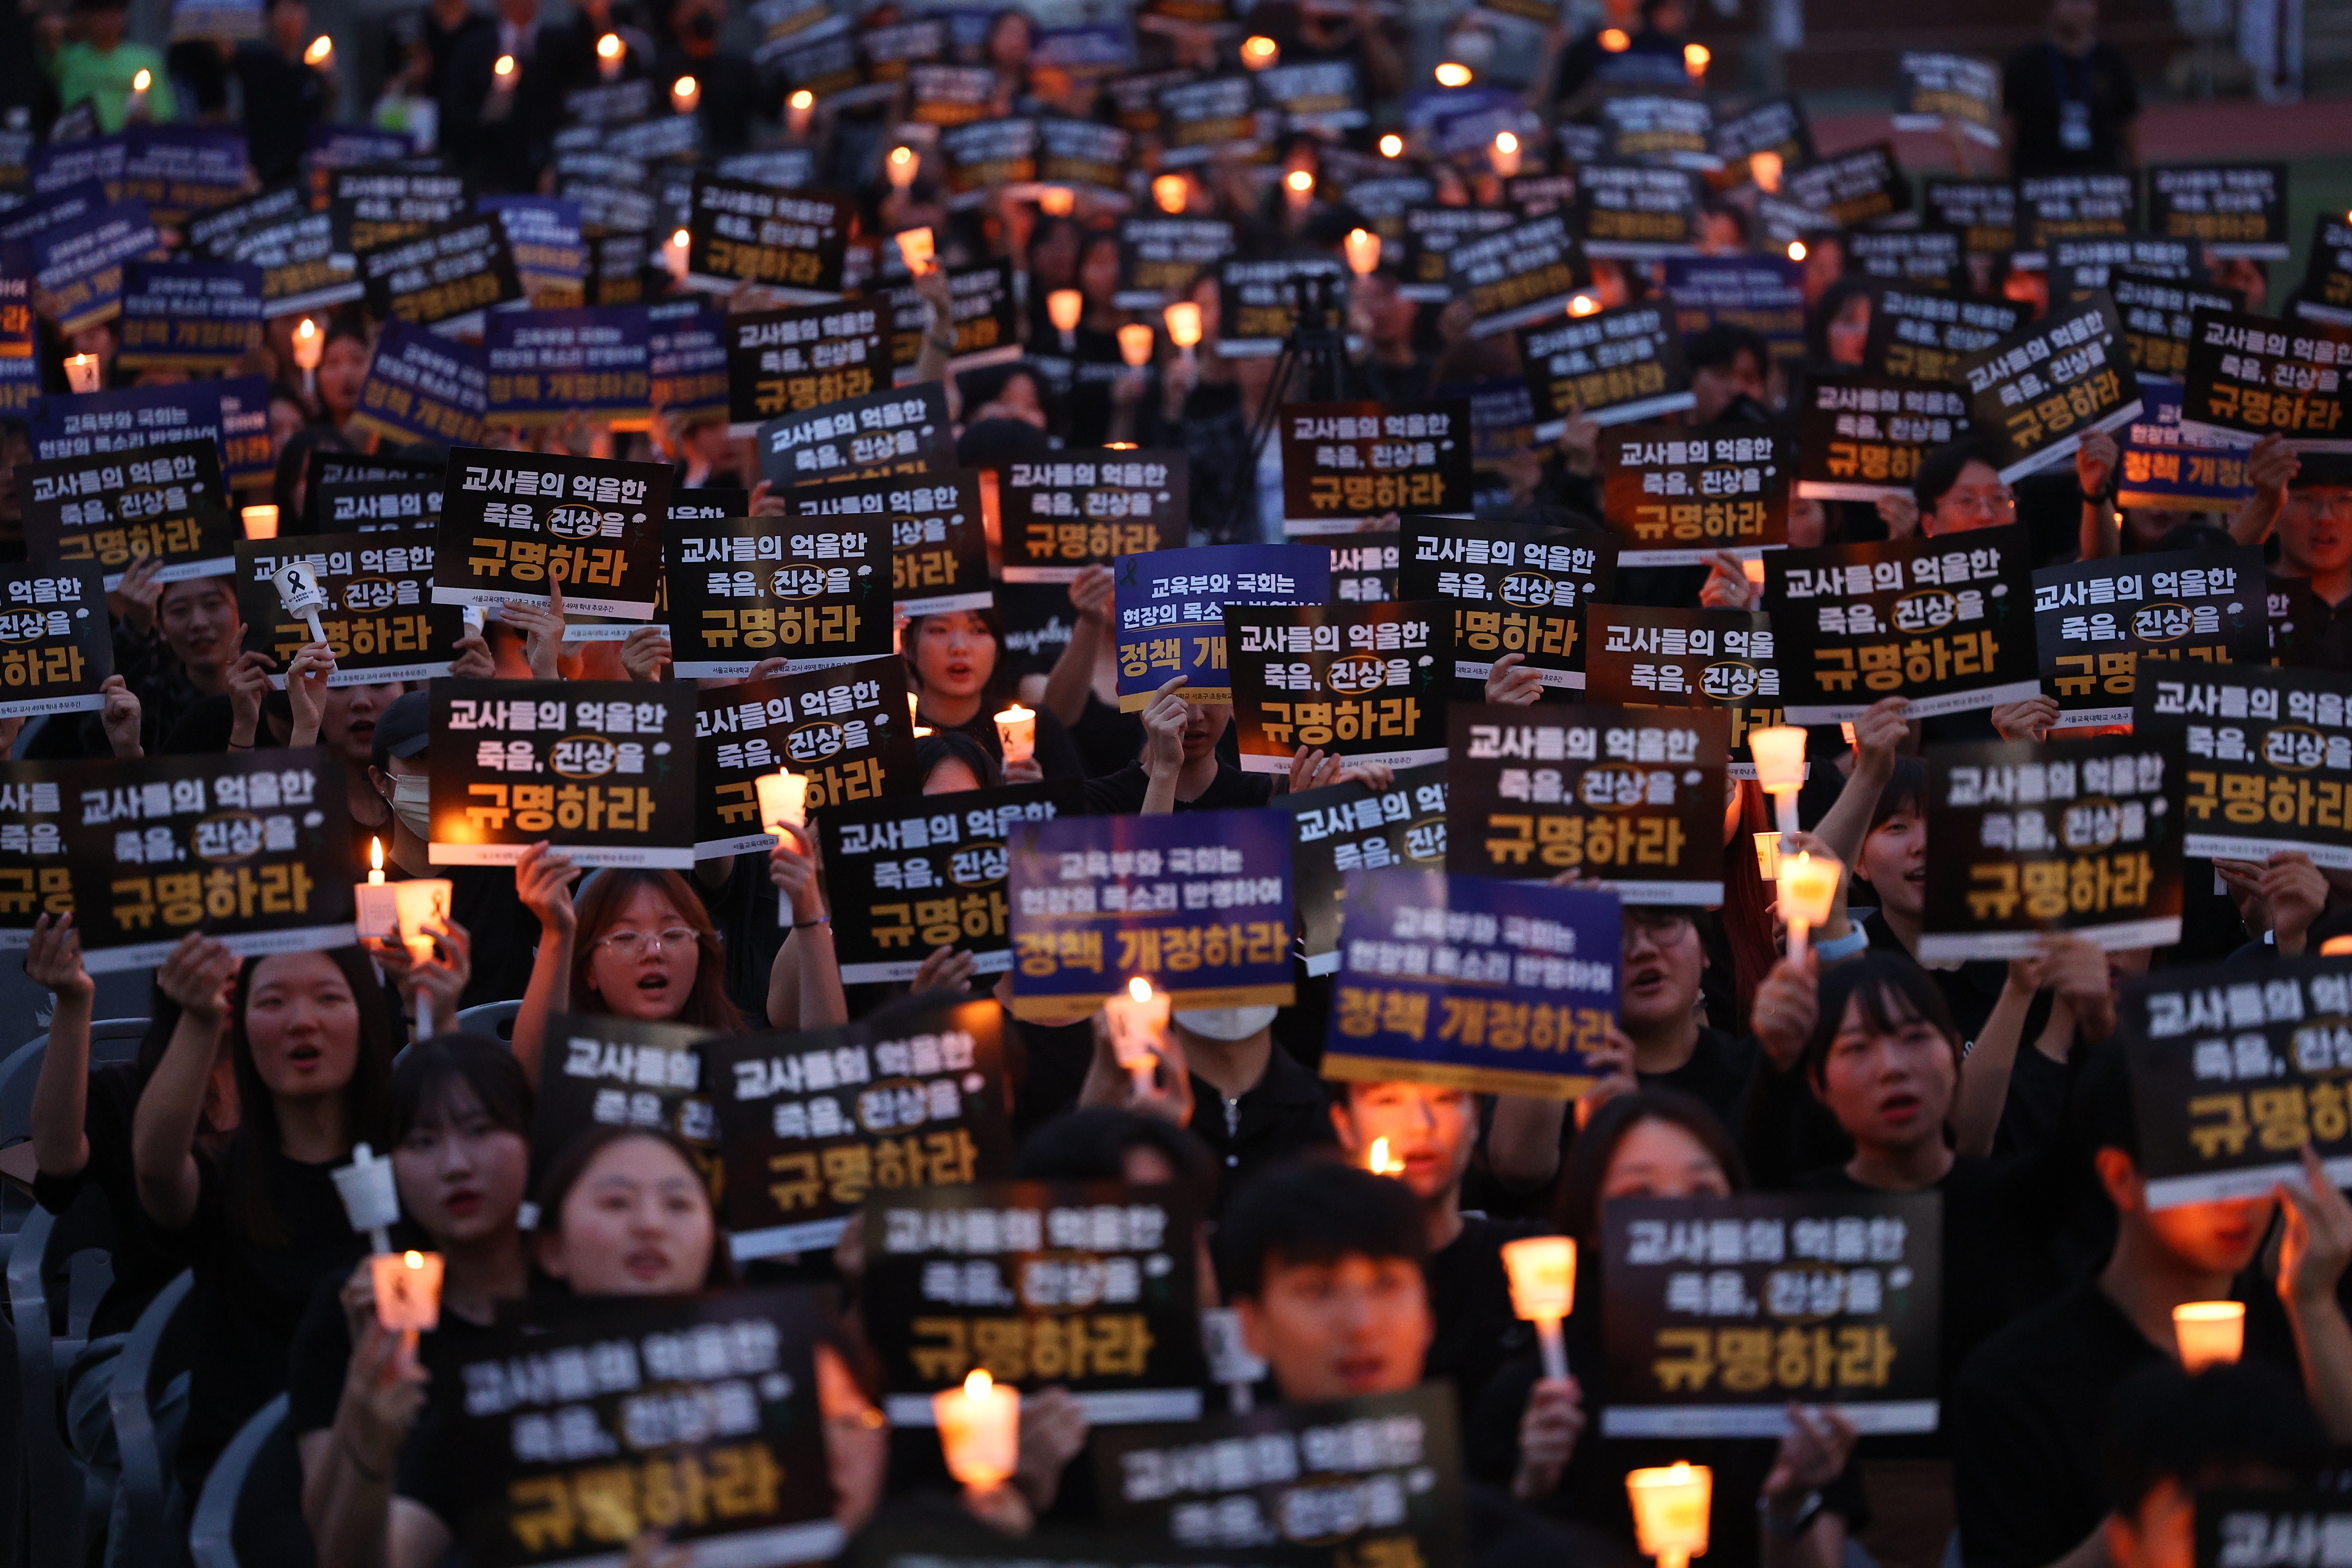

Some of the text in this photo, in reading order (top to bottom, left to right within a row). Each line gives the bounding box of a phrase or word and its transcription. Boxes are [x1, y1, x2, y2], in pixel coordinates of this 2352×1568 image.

[740, 311, 875, 348] 교사들의 억울한
[2205, 323, 2287, 358] 교사들의
[762, 339, 865, 371] 죽음, 진상을
[1966, 310, 2106, 393] 교사들의 억울한
[756, 369, 873, 412] 규명하라
[1998, 342, 2106, 406] 죽음, 진상을
[2222, 354, 2338, 391] 죽음, 진상을
[2005, 369, 2119, 448] 규명하라
[2209, 380, 2341, 429] 규명하라
[772, 399, 926, 452] 교사들의 억울한
[1295, 414, 1449, 439] 교사들의 억울한
[796, 430, 917, 469] 죽음, 진상을
[1317, 443, 1435, 468] 죽음, 진상을
[1621, 438, 1772, 465] 교사들의 억울한
[33, 456, 195, 502] 교사들의 억울한
[462, 467, 646, 504] 교사들의 억울한
[1012, 464, 1167, 486] 교사들의 억울한
[1311, 473, 1445, 509] 규명하라
[1643, 469, 1760, 495] 죽음, 진상을
[61, 487, 187, 525] 죽음, 진상을
[335, 494, 421, 519] 교사들의
[484, 503, 624, 537] 죽음, 진상을
[1033, 493, 1151, 517] 죽음, 진상을
[1634, 502, 1766, 539] 규명하라
[682, 533, 867, 562] 교사들의 억울한
[1027, 523, 1159, 557] 규명하라
[1416, 536, 1595, 574] 교사들의 억울한
[361, 547, 435, 573] 억울한
[469, 538, 628, 586] 규명하라
[1786, 548, 2001, 597] 교사들의 억울한
[9, 577, 81, 603] 억울한
[347, 580, 419, 608] 진상을
[707, 568, 850, 597] 죽음, 진상을
[1152, 573, 1295, 598] 교육부와 국회는
[1438, 573, 1576, 607] 죽음, 진상을
[2034, 568, 2236, 613] 교사들의 억울한
[702, 605, 860, 648] 규명하라
[1123, 603, 1177, 630] 현장의
[1818, 590, 1984, 634] 죽음, 진상을
[2062, 605, 2219, 641] 죽음, 진상을
[1241, 622, 1429, 652] 교사들의 억울한
[1606, 626, 1714, 656] 교사들의
[1121, 639, 1180, 677] 정책
[1265, 659, 1410, 691] 죽음, 진상을
[1815, 629, 1998, 690] 규명하라
[801, 680, 881, 716] 억울한
[1631, 664, 1779, 699] 죽음, 진상을
[449, 701, 667, 733] 교사들의 억울한
[2065, 714, 2108, 723] 서울교육대학교
[2155, 682, 2278, 720] 교사들의
[1262, 697, 1420, 744] 규명하라
[477, 741, 645, 773] 죽음, 진상을
[718, 720, 869, 768] 죽음, 진상을
[1469, 726, 1699, 762] 교사들의 억울한
[2188, 726, 2255, 762] 죽음,
[82, 770, 315, 825] 교사들의 억울한
[1500, 769, 1675, 805] 죽음, 진상을
[1951, 756, 2163, 803] 교사들의 억울한
[466, 785, 654, 833] 규명하라
[1296, 791, 1412, 841] 교사들의
[1984, 803, 2144, 849] 죽음, 진상을
[115, 814, 296, 863] 죽음, 진상을
[840, 814, 959, 855] 교사들의
[1487, 815, 1684, 865] 규명하라
[874, 858, 942, 889] 죽음,
[1059, 848, 1242, 880] 교육부와 국회는
[1335, 838, 1400, 874] 죽음,
[112, 863, 313, 928] 규명하라
[1021, 878, 1281, 916] 현장의 목소리 반영하여
[1969, 854, 2152, 918] 규명하라
[1016, 923, 1289, 974] 정책 개정하라
[1342, 989, 1427, 1038] 정책
[736, 1032, 976, 1099] 교사들의 억울한
[776, 1080, 959, 1136] 죽음, 진상을
[770, 1131, 976, 1209] 규명하라
